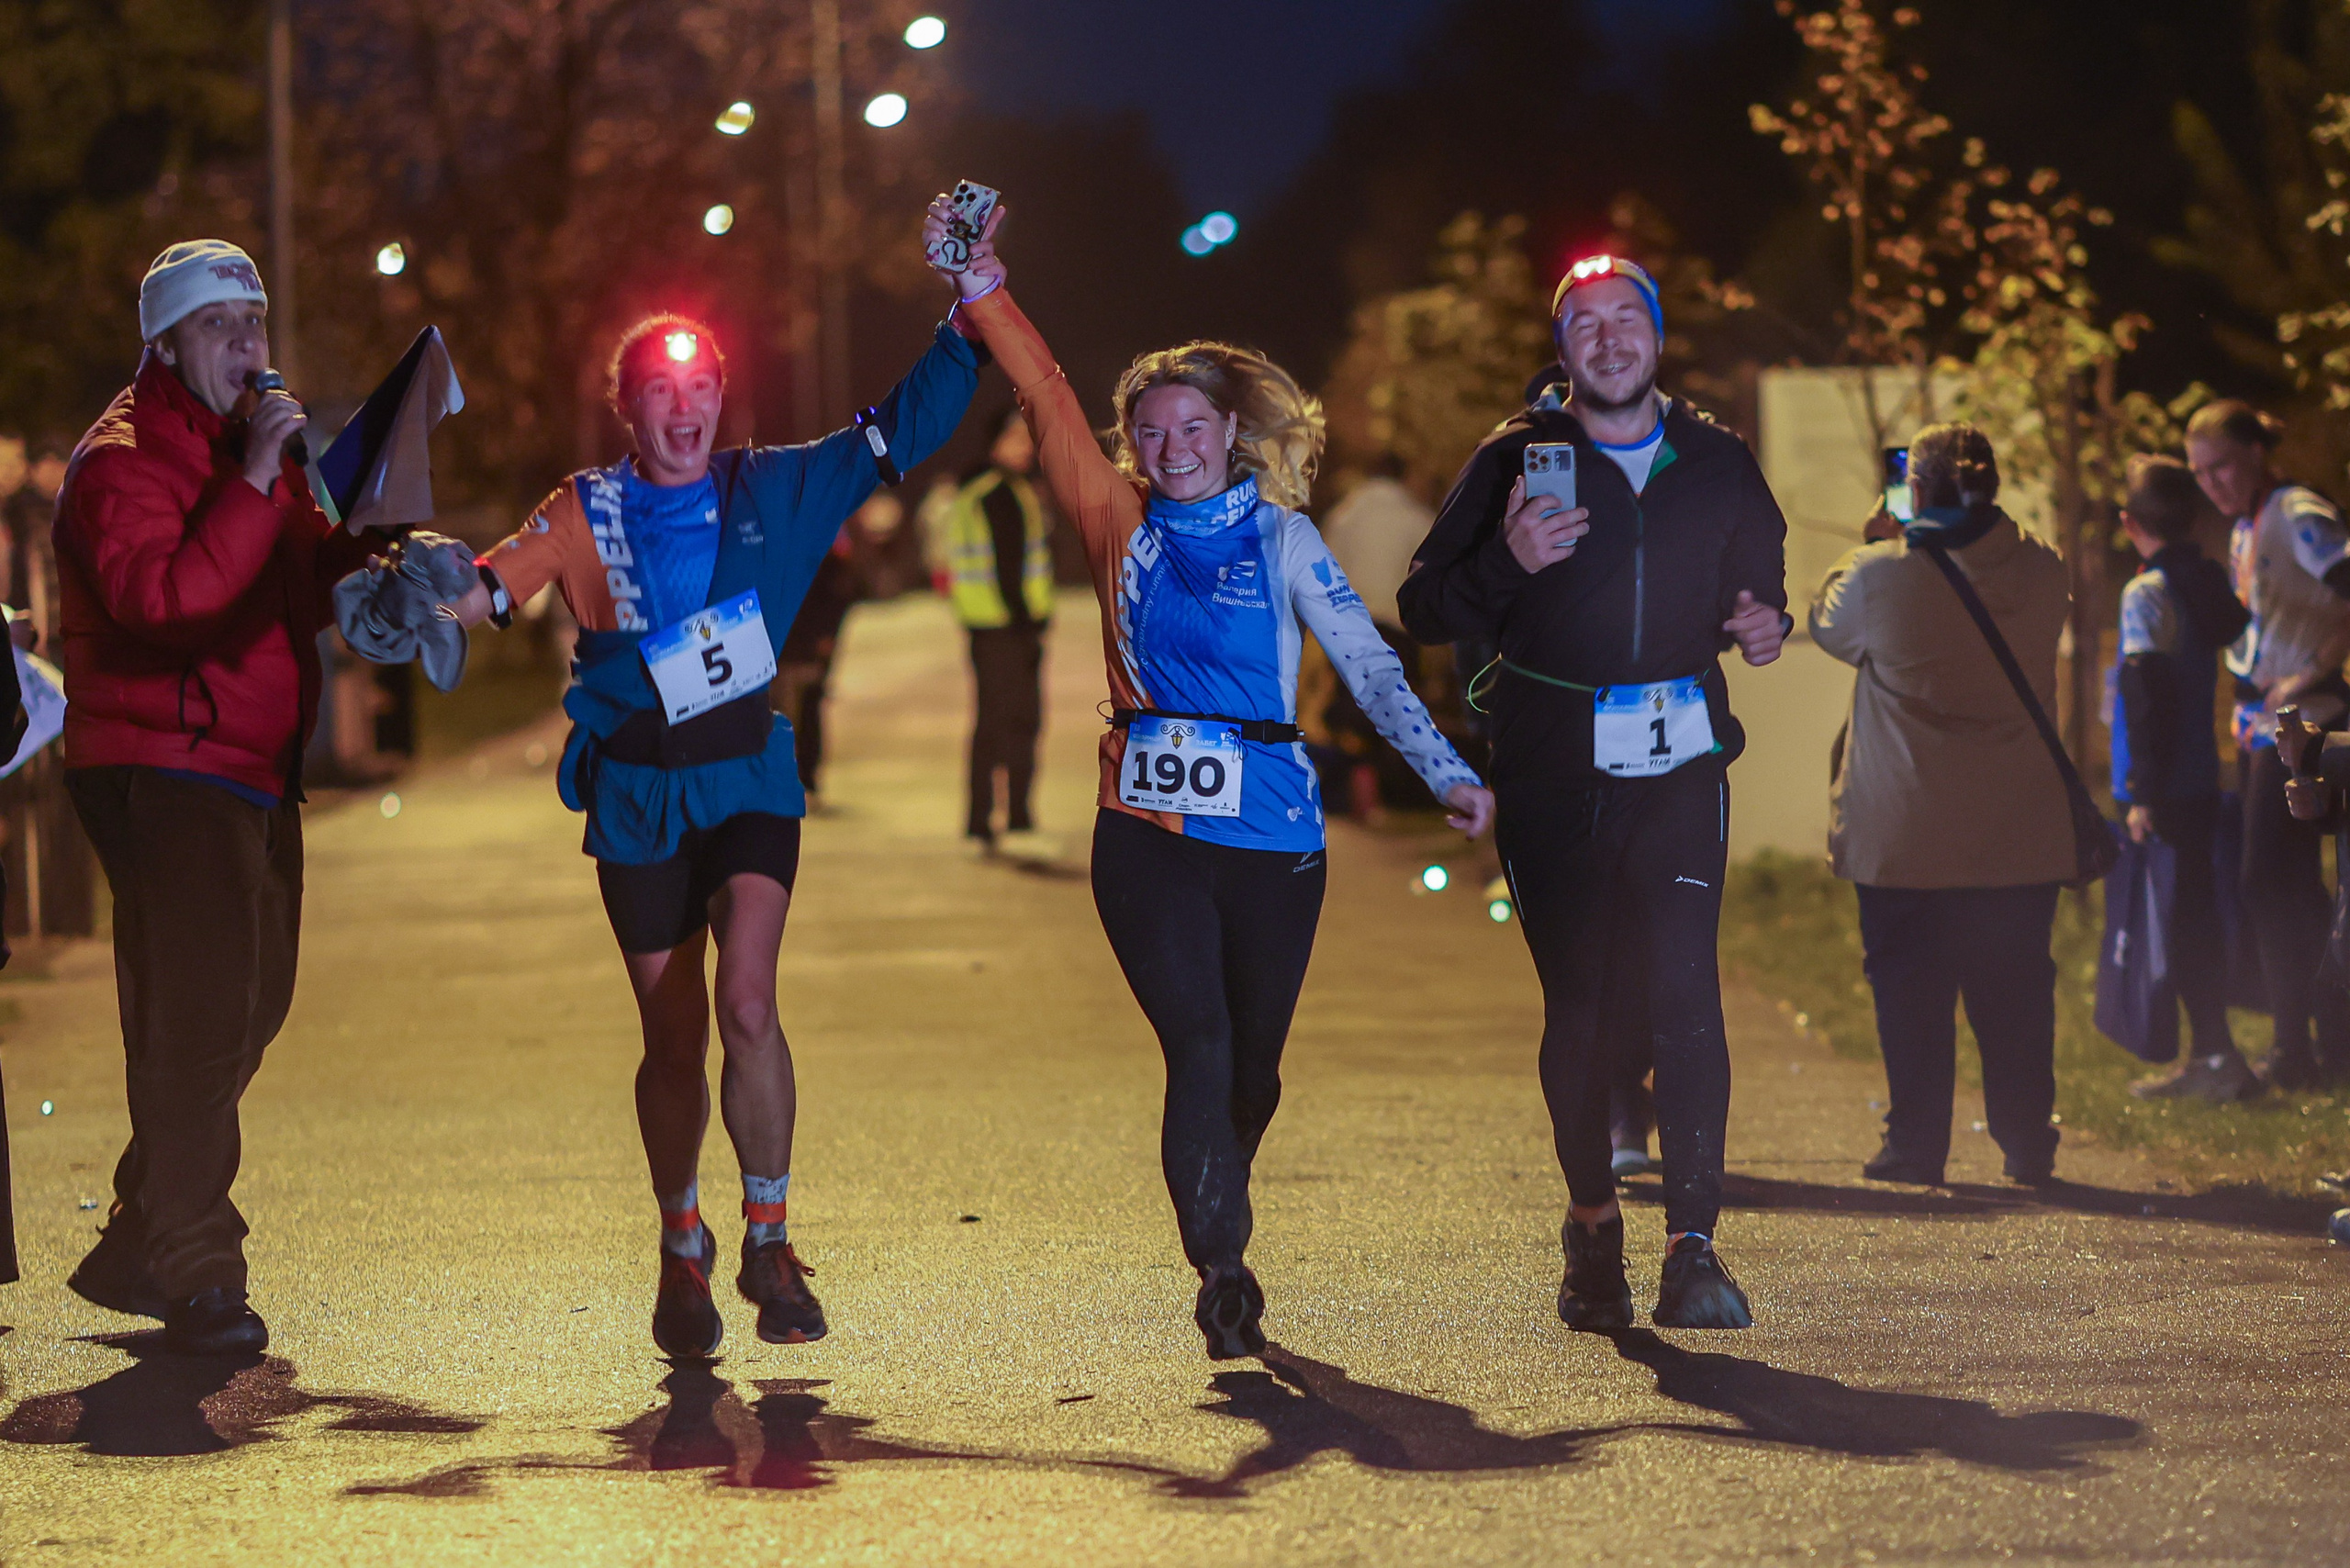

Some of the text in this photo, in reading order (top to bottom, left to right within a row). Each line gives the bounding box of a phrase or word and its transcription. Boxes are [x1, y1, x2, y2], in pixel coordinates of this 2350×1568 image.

[1216, 581, 1257, 597] Валерия
[700, 641, 733, 687] 5
[1650, 717, 1672, 756] 1
[1133, 751, 1225, 797] 190
